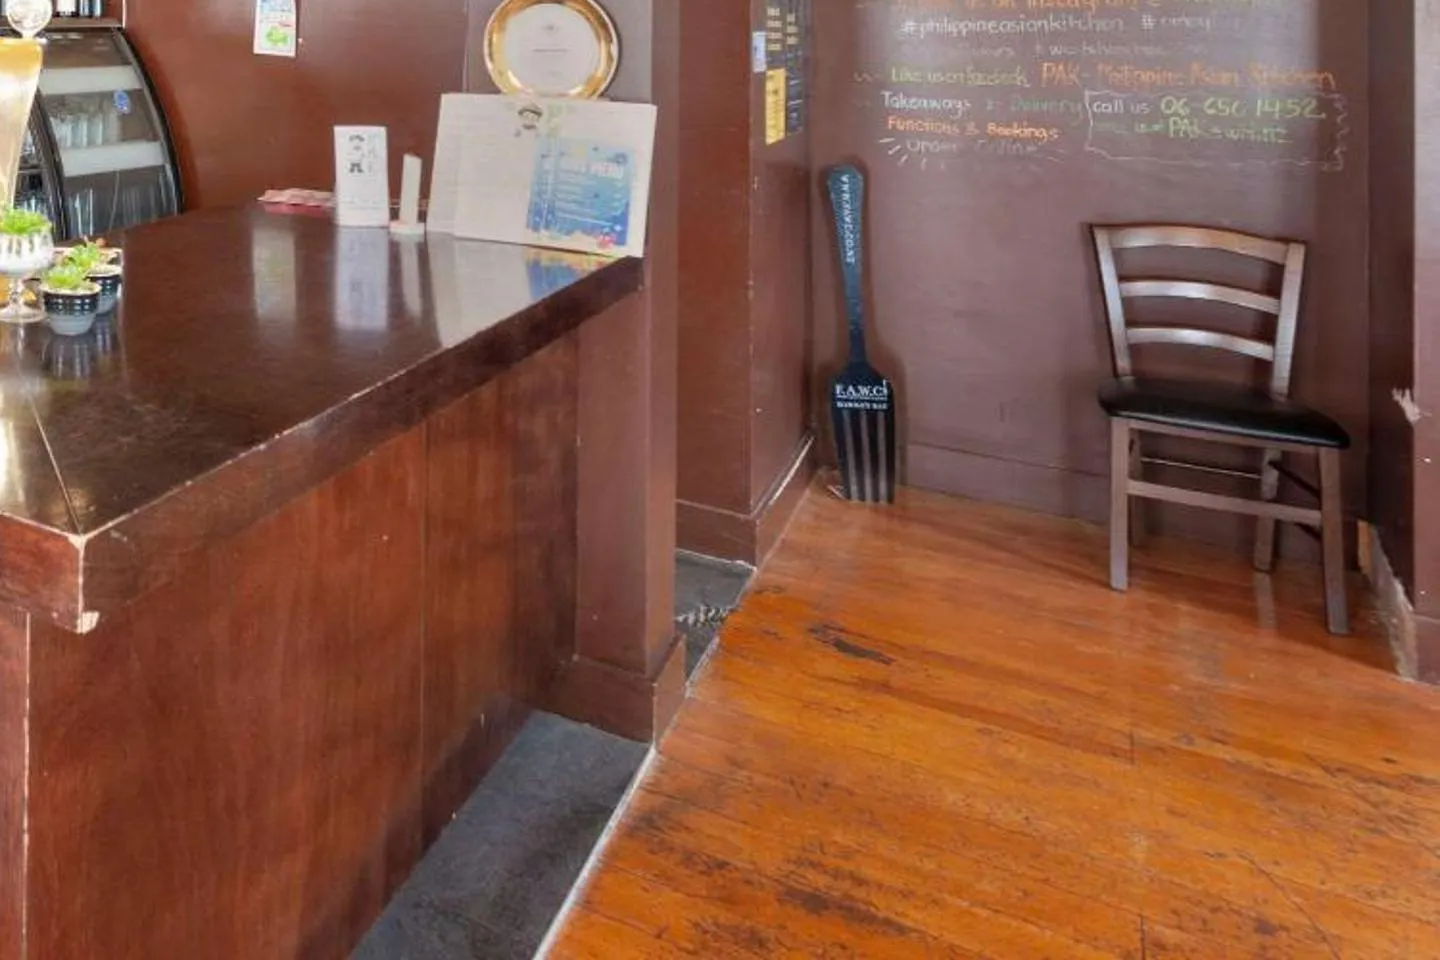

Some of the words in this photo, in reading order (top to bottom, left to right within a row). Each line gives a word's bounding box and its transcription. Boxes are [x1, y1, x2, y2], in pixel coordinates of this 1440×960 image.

[880, 91, 971, 118] Takeaways
[1092, 98, 1124, 114] call
[987, 121, 1061, 145] Bookings
